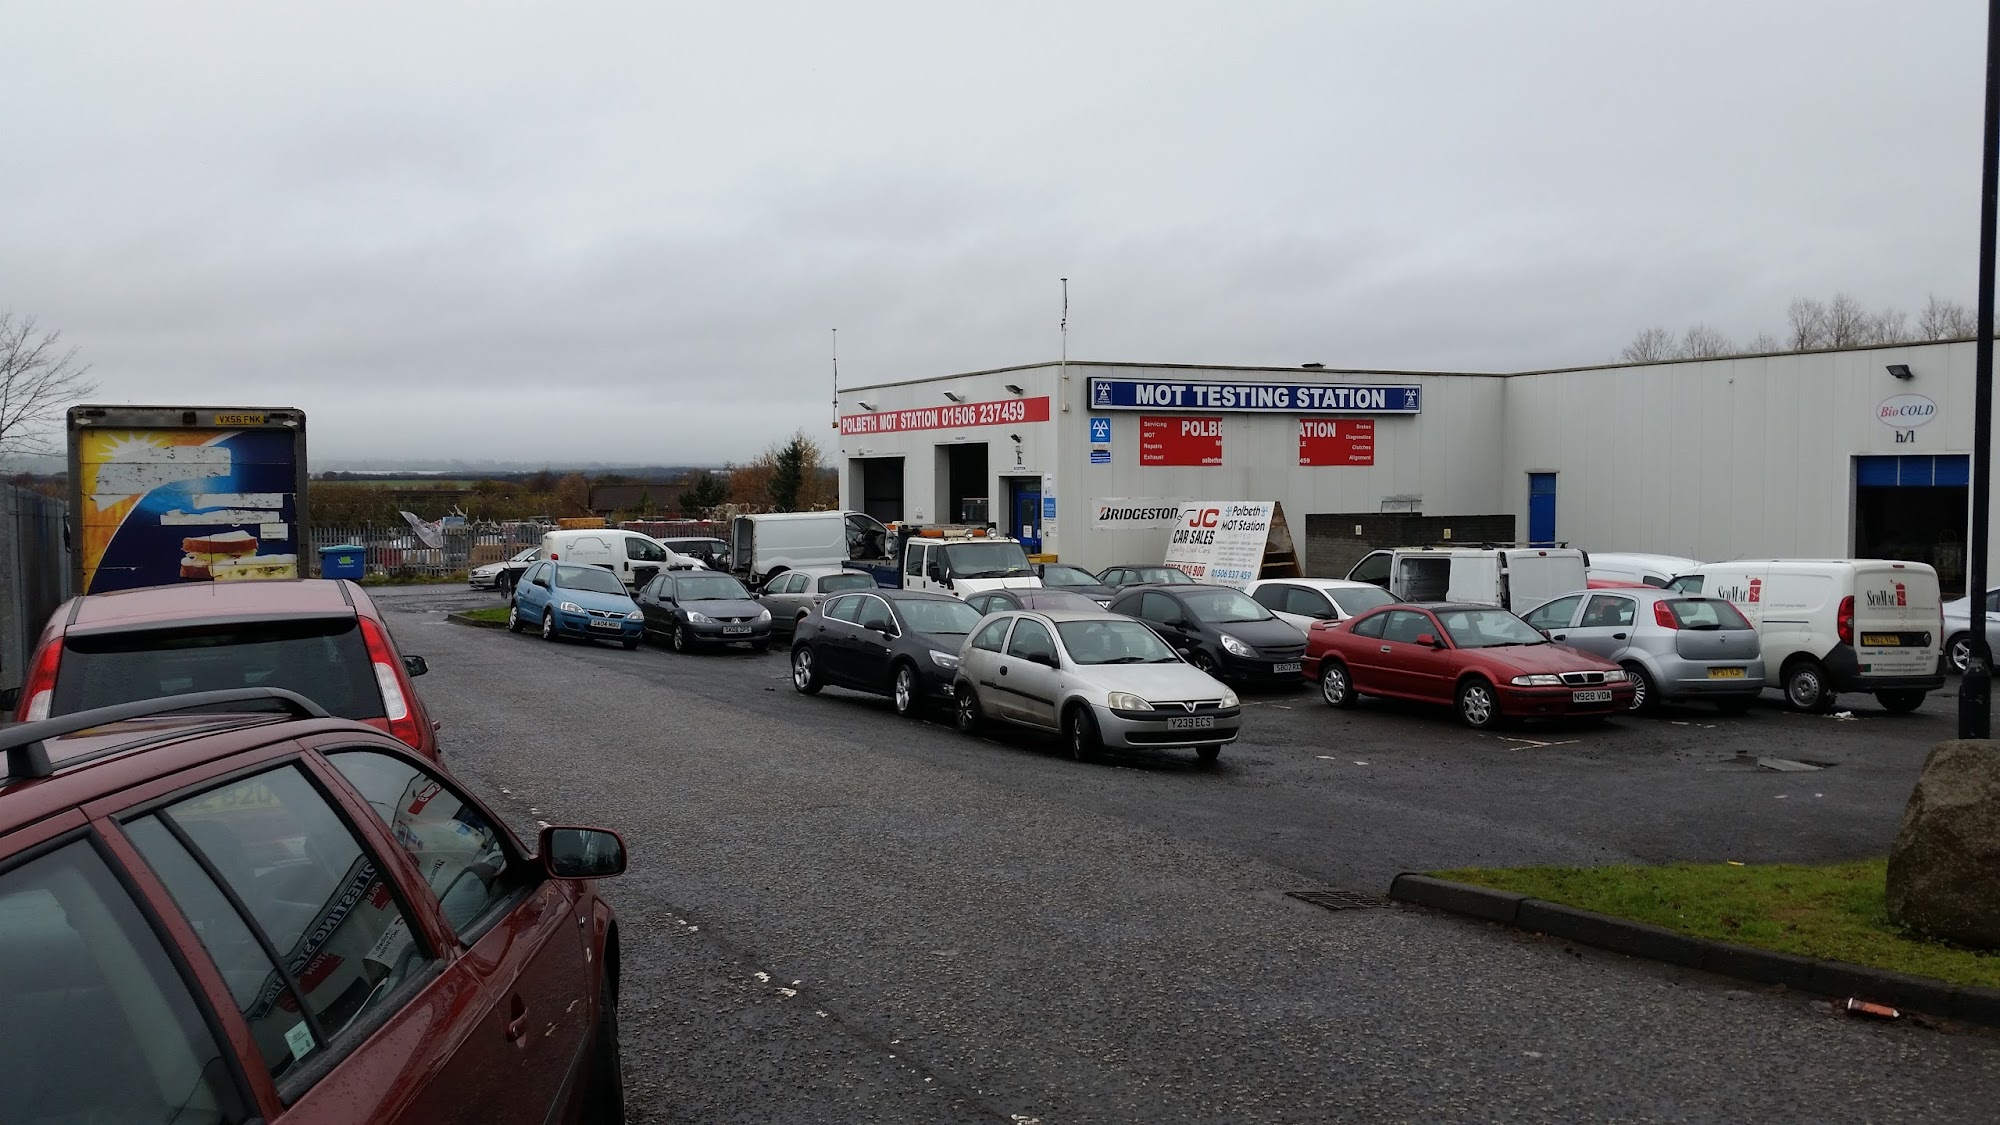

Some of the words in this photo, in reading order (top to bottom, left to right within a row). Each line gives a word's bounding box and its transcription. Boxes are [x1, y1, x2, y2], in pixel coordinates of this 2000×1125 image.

[1136, 384, 1186, 406] MOT
[1193, 386, 1290, 408] TESTING
[1296, 387, 1385, 409] STATION
[219, 415, 242, 423] VX56
[842, 417, 877, 434] POLBETH
[880, 414, 898, 431] MOT
[900, 409, 939, 429] STATION
[942, 405, 976, 426] 01506
[980, 401, 1025, 424] 237459
[1143, 421, 1168, 429] Servicing
[1345, 433, 1372, 441] Diagnostics
[1231, 505, 1261, 517] Polbeth
[1189, 508, 1220, 528] JC
[1220, 519, 1239, 531] MOT
[1238, 520, 1266, 532] Station
[1173, 530, 1190, 545] CAR
[1189, 530, 1215, 545] SALES
[1211, 568, 1227, 578] 01506
[1574, 692, 1595, 701] N928
[1596, 691, 1611, 700] VOA
[1171, 718, 1194, 728] Y239
[1195, 717, 1211, 727] ECS
